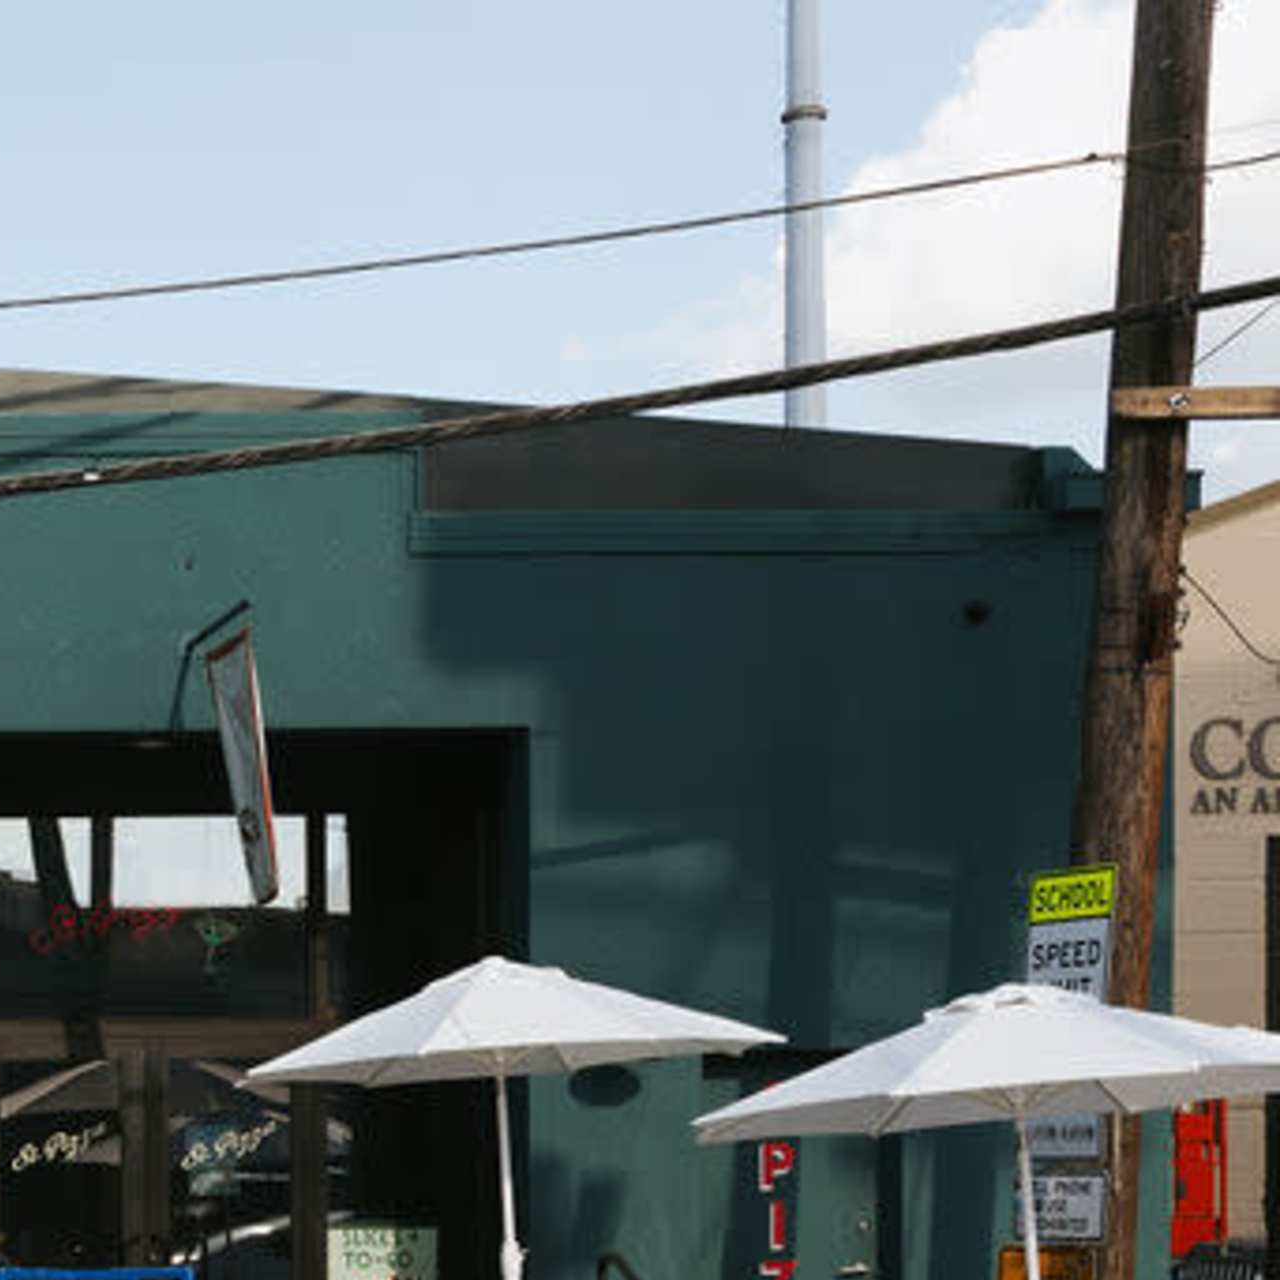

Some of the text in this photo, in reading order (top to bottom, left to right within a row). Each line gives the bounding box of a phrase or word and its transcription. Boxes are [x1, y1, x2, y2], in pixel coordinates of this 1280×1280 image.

[1190, 787, 1280, 815] AN A
[1035, 879, 1107, 912] SCHOOL
[1033, 940, 1100, 970] SPEED
